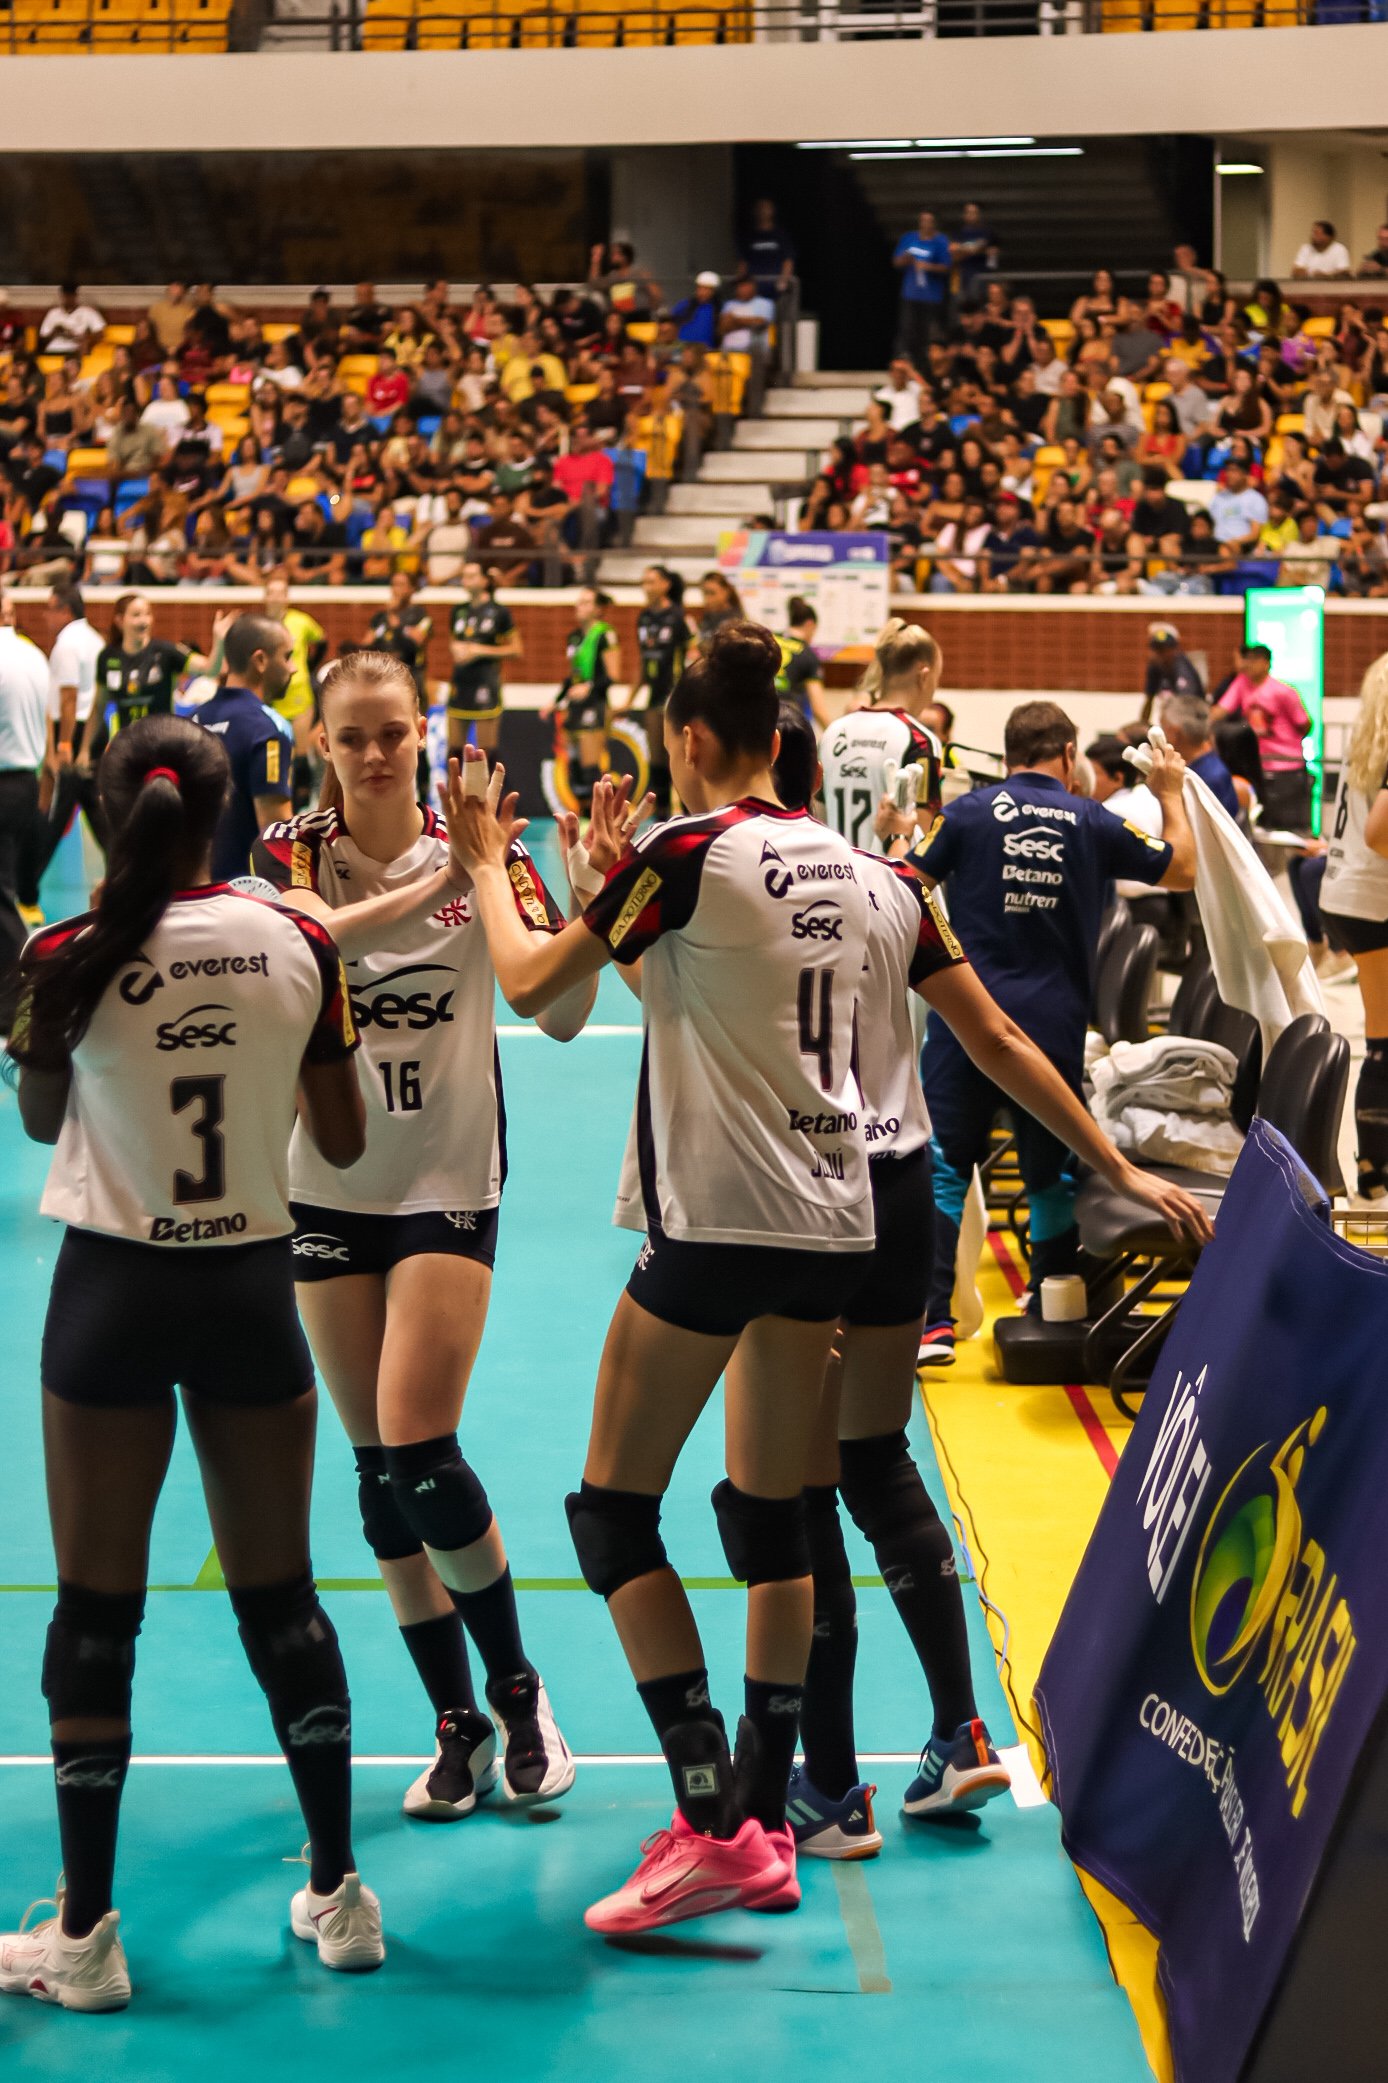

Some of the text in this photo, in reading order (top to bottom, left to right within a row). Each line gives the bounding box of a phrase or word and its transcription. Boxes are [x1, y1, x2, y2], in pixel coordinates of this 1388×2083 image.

[1021, 803, 1077, 826] everest
[797, 862, 857, 885] everest
[1002, 864, 1063, 886] Betano
[1004, 891, 1058, 909] nutren
[169, 951, 269, 980] everest
[798, 967, 835, 1092] 4
[378, 1060, 423, 1113] 16
[170, 1072, 226, 1206] 3
[149, 1212, 247, 1243] Betano
[1136, 1363, 1212, 1605] VÔLEI
